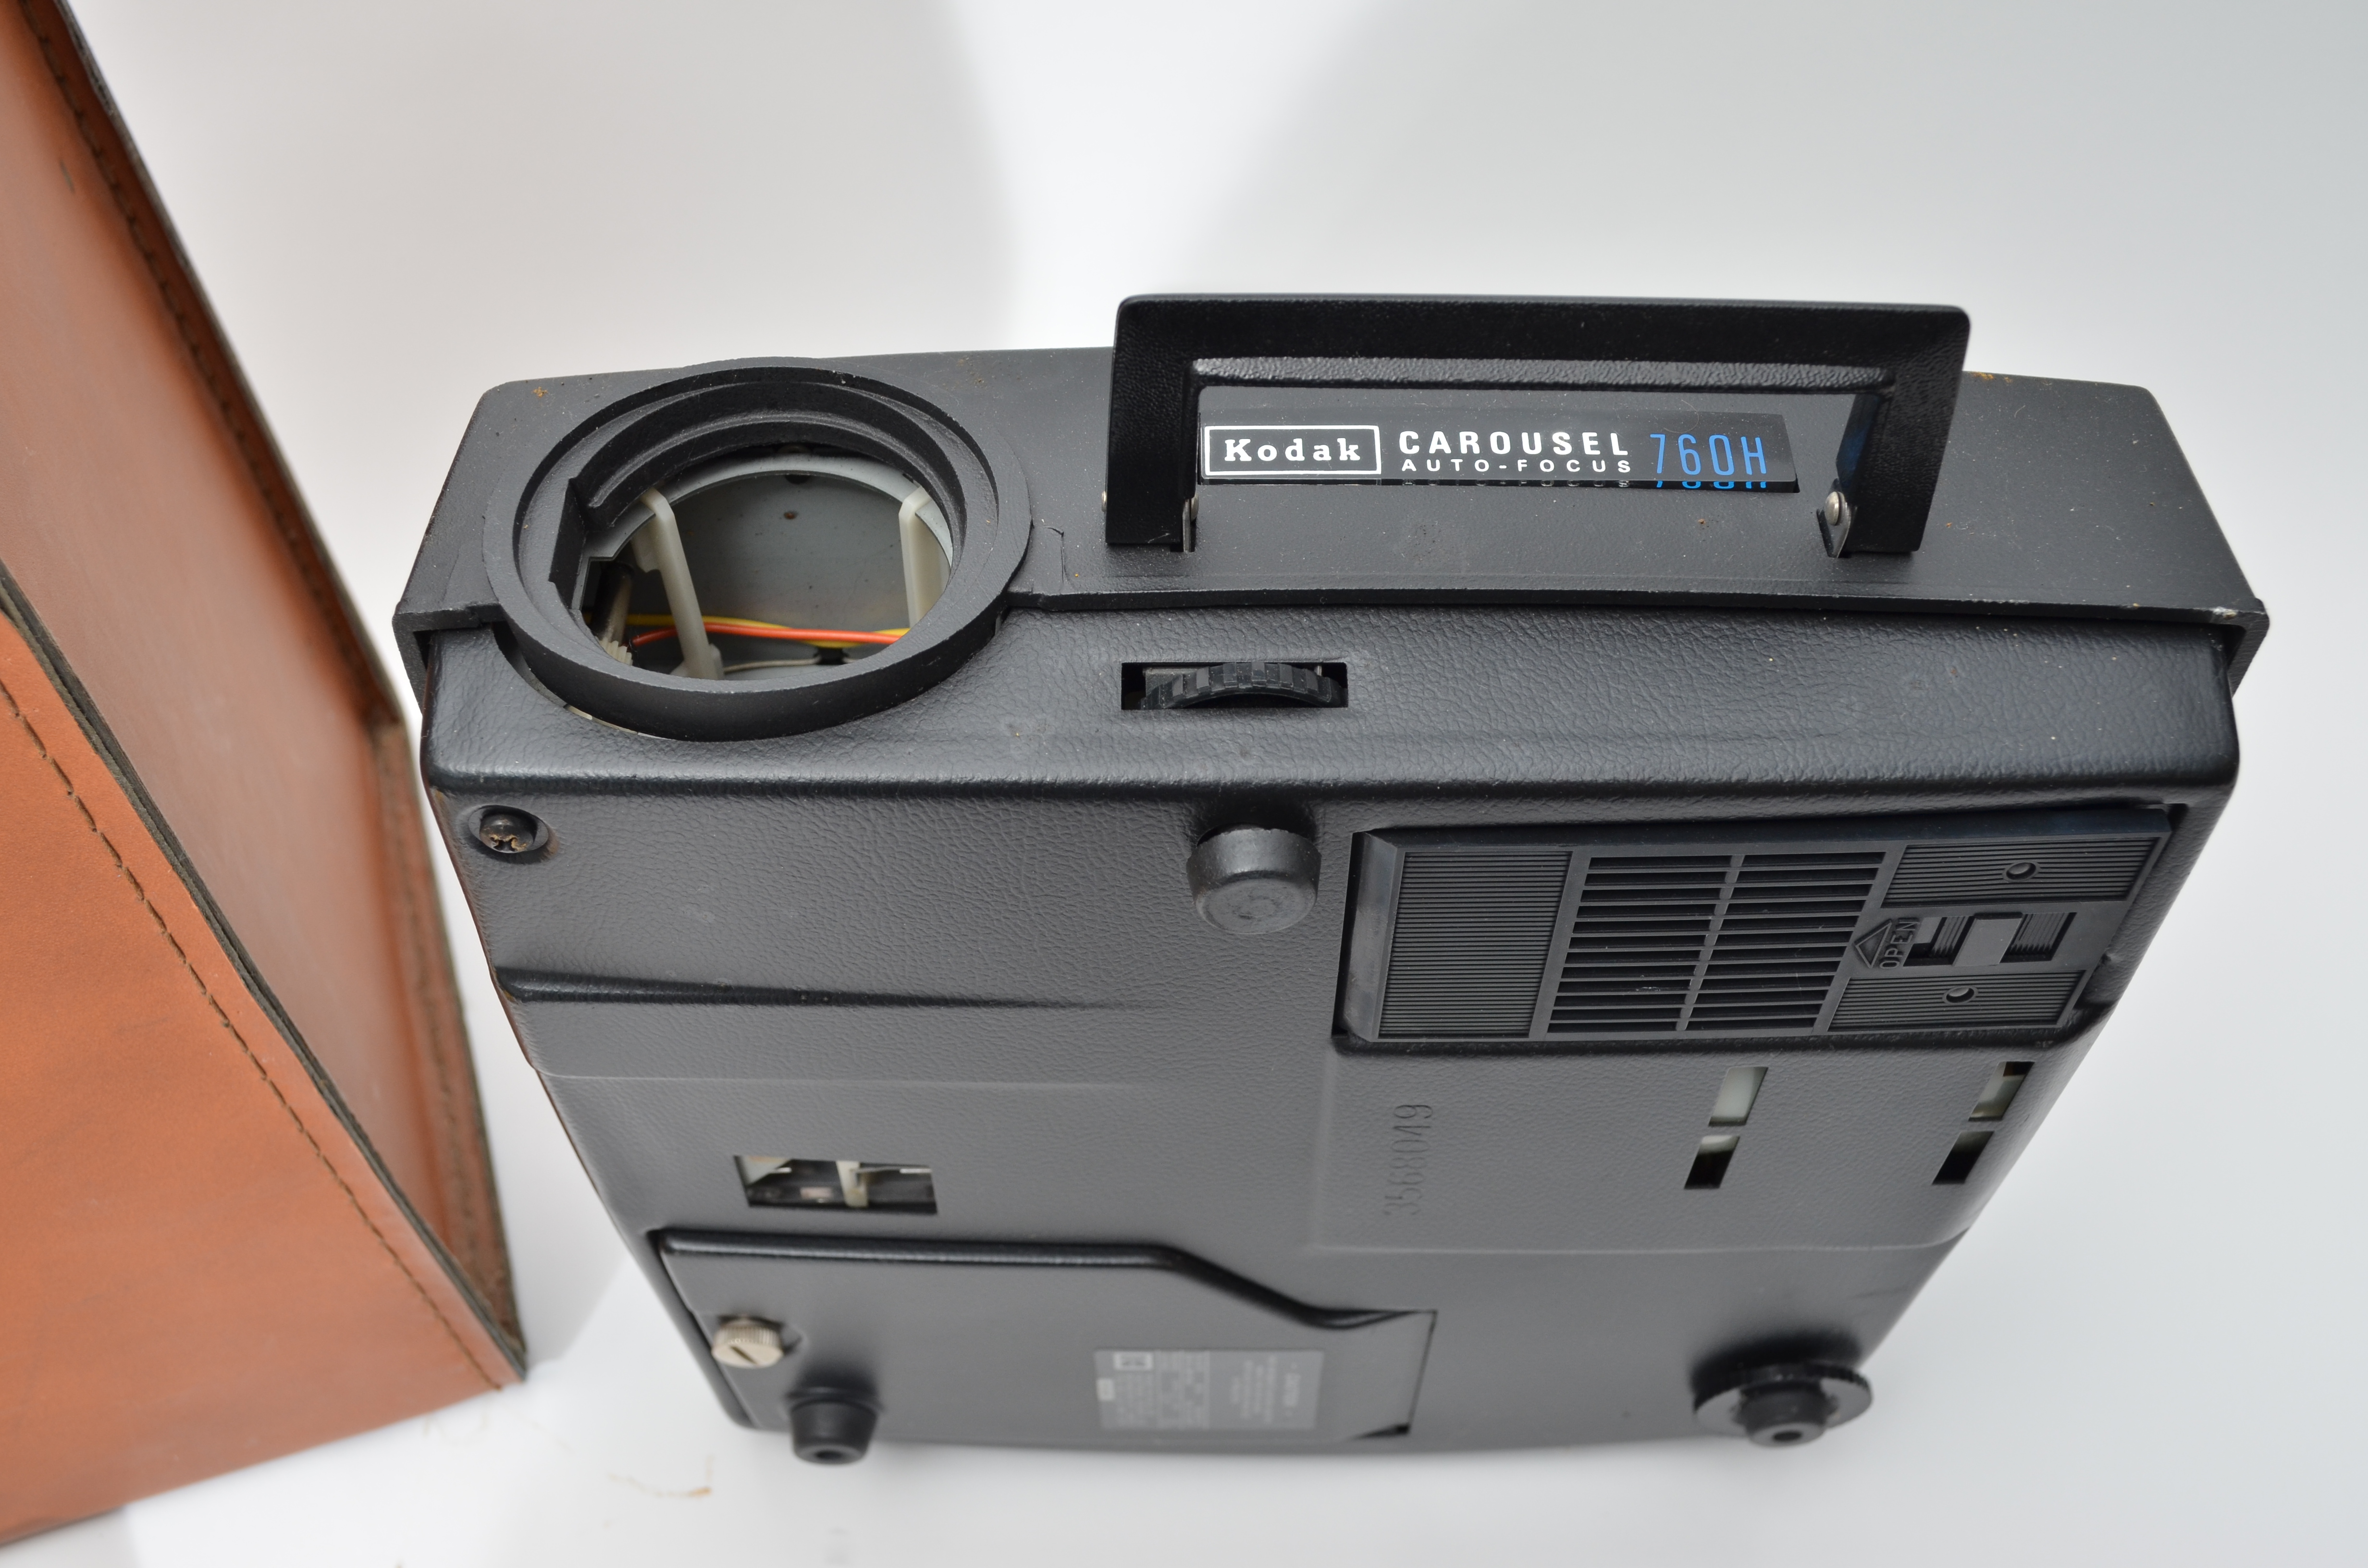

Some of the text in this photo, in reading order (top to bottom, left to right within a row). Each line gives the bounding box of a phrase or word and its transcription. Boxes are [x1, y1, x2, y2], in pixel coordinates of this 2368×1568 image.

[1224, 438, 1361, 462] Kodak
[1399, 430, 1628, 456] CAROUSEL
[1650, 433, 1767, 476] 760H
[1401, 458, 1631, 473] AUTO-FOCUS
[1879, 919, 1920, 969] OPEN
